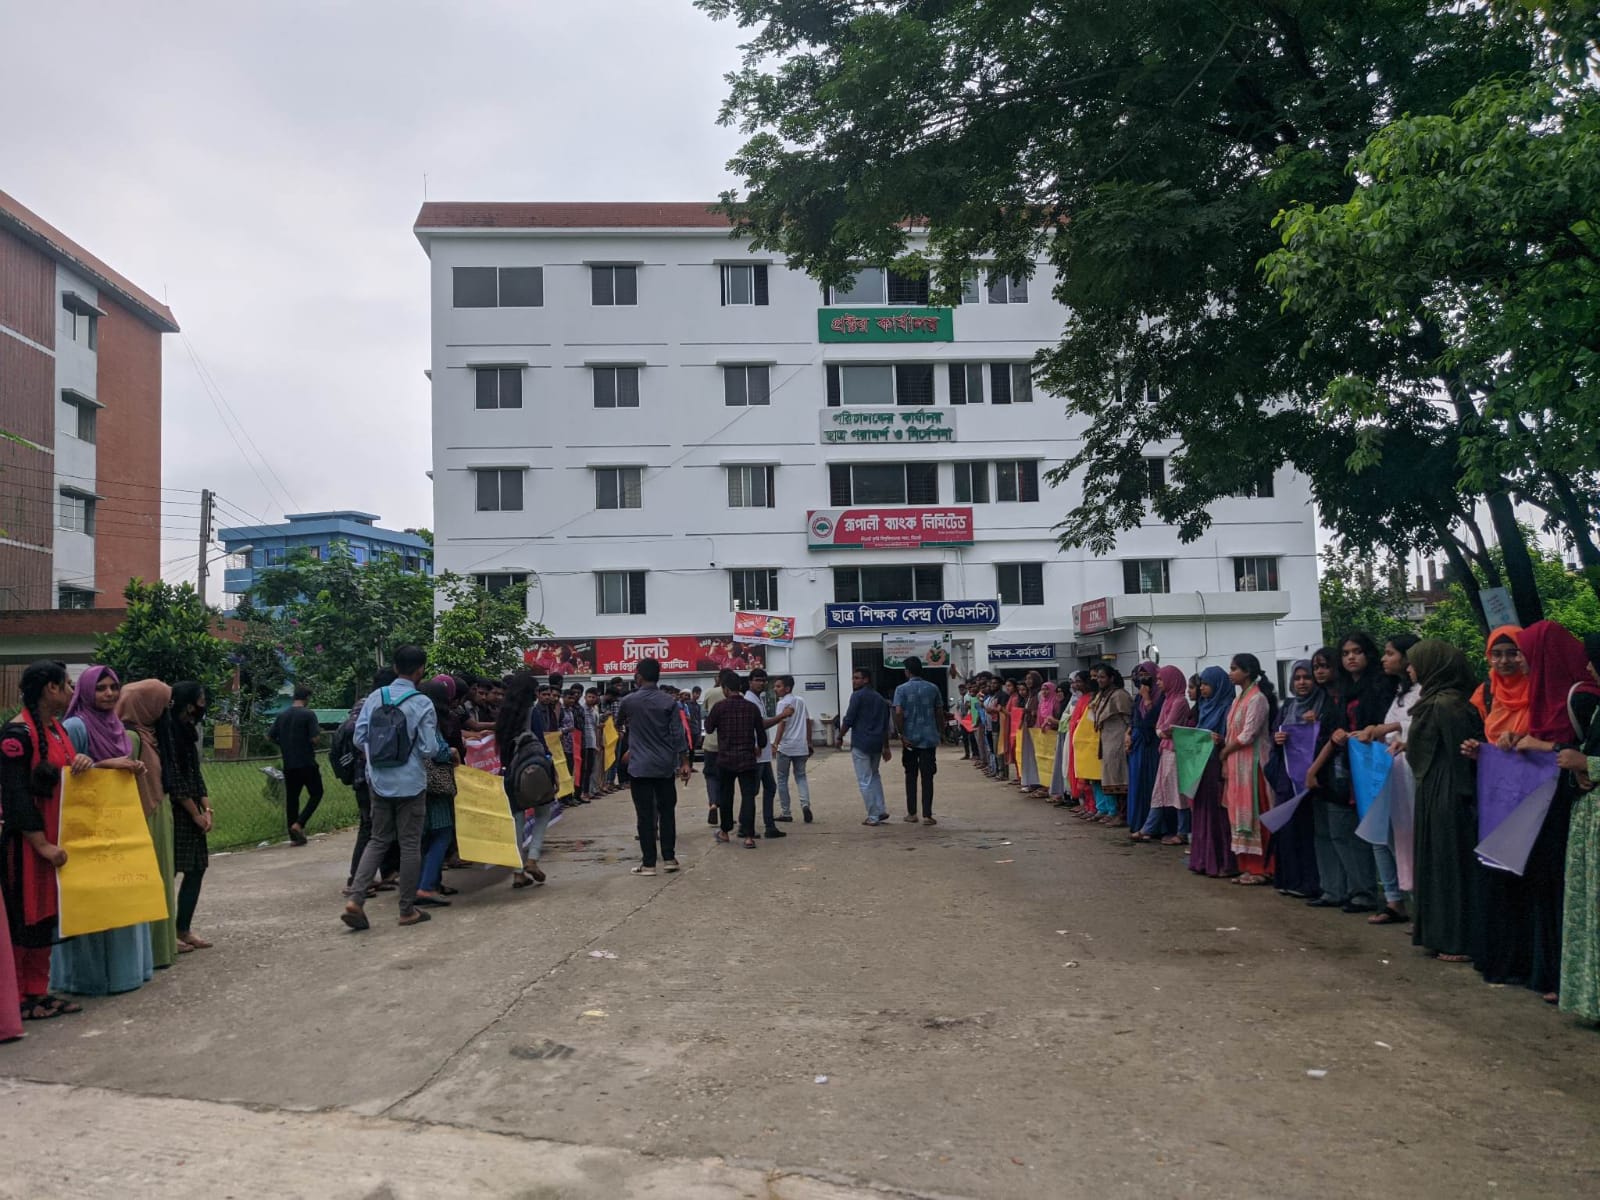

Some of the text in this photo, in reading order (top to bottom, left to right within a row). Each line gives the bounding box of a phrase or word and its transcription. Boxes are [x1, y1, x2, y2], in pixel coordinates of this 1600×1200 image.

[899, 409, 944, 424] কার্যালয়
[824, 426, 953, 443] ছাত্র পরামর্শ ও নির্দেশনা
[844, 513, 967, 532] রূপালী ব্যাংক লিমিটেড
[831, 602, 996, 624] ছাত্র শিক্ষক কেন্দ্র (টিএসসি)
[622, 638, 670, 661] সিলেট
[603, 661, 618, 674] কৃষি
